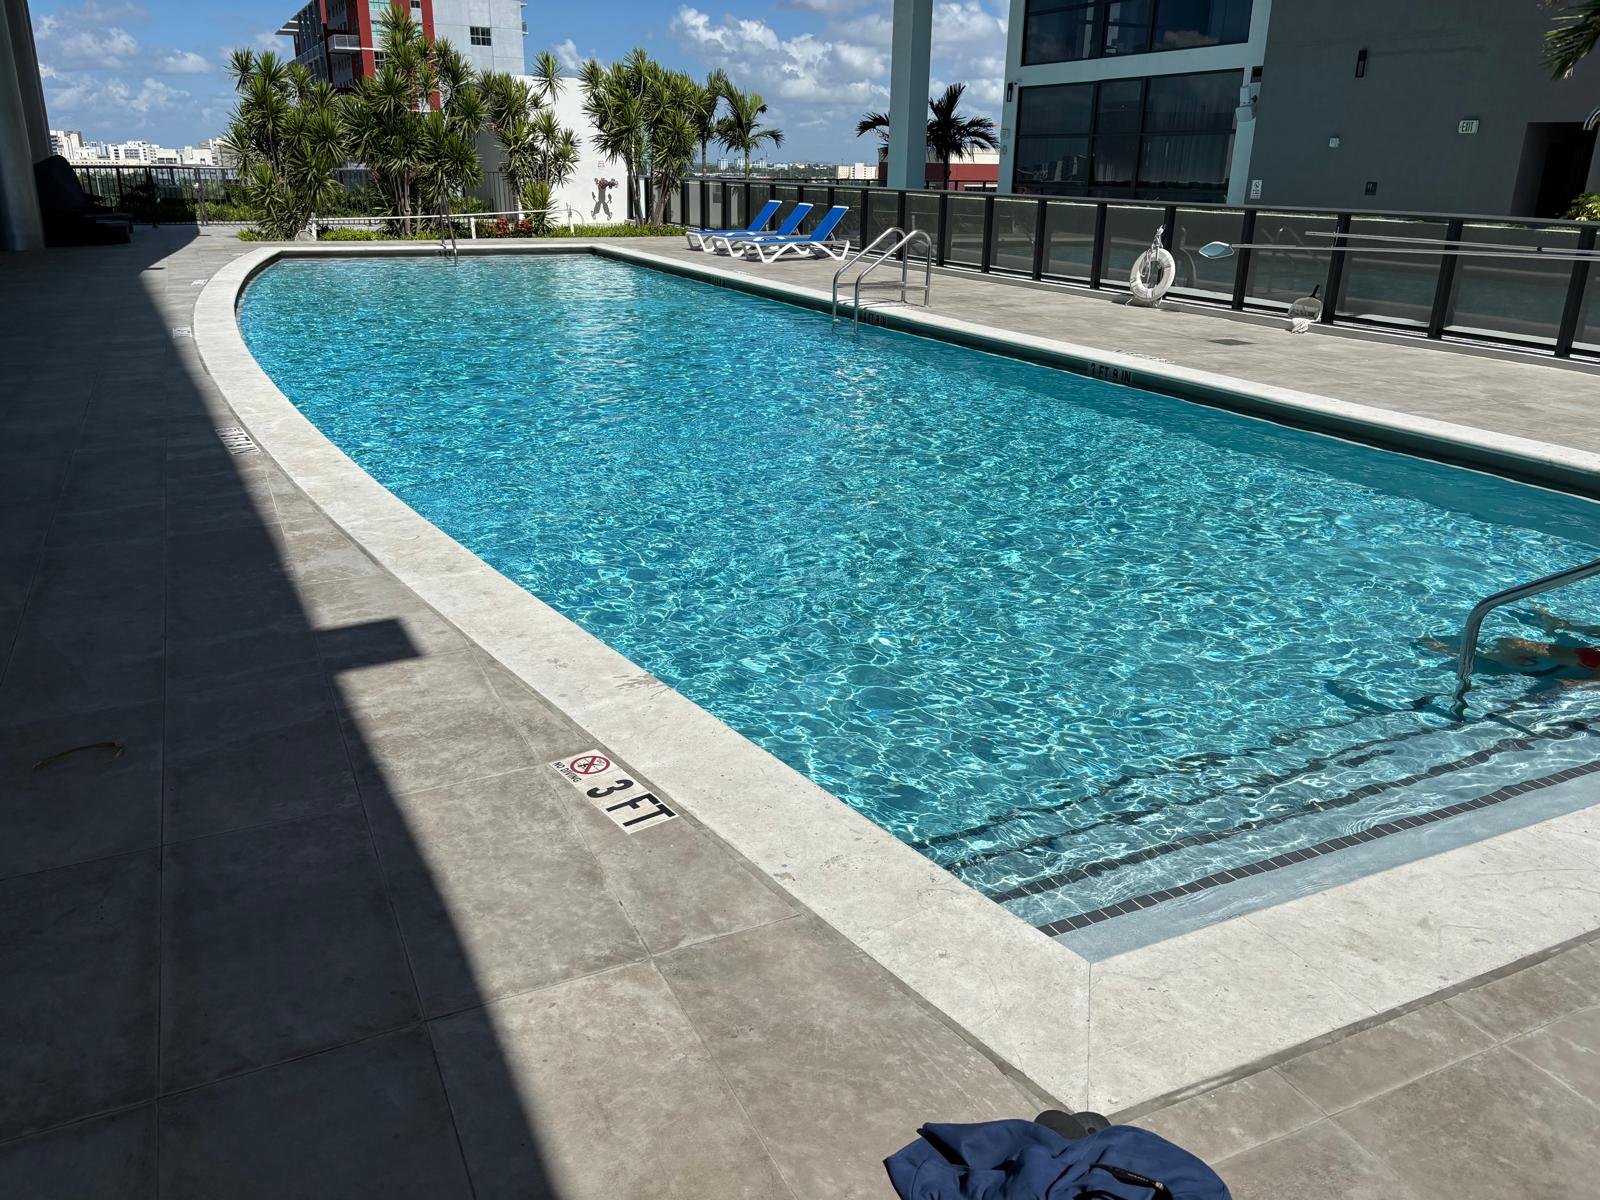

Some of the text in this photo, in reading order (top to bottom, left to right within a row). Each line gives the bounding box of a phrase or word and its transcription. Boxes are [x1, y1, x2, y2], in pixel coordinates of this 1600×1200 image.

[1460, 121, 1475, 133] EXIT
[553, 761, 582, 783] NO DIVING
[586, 779, 676, 827] 3 FT
